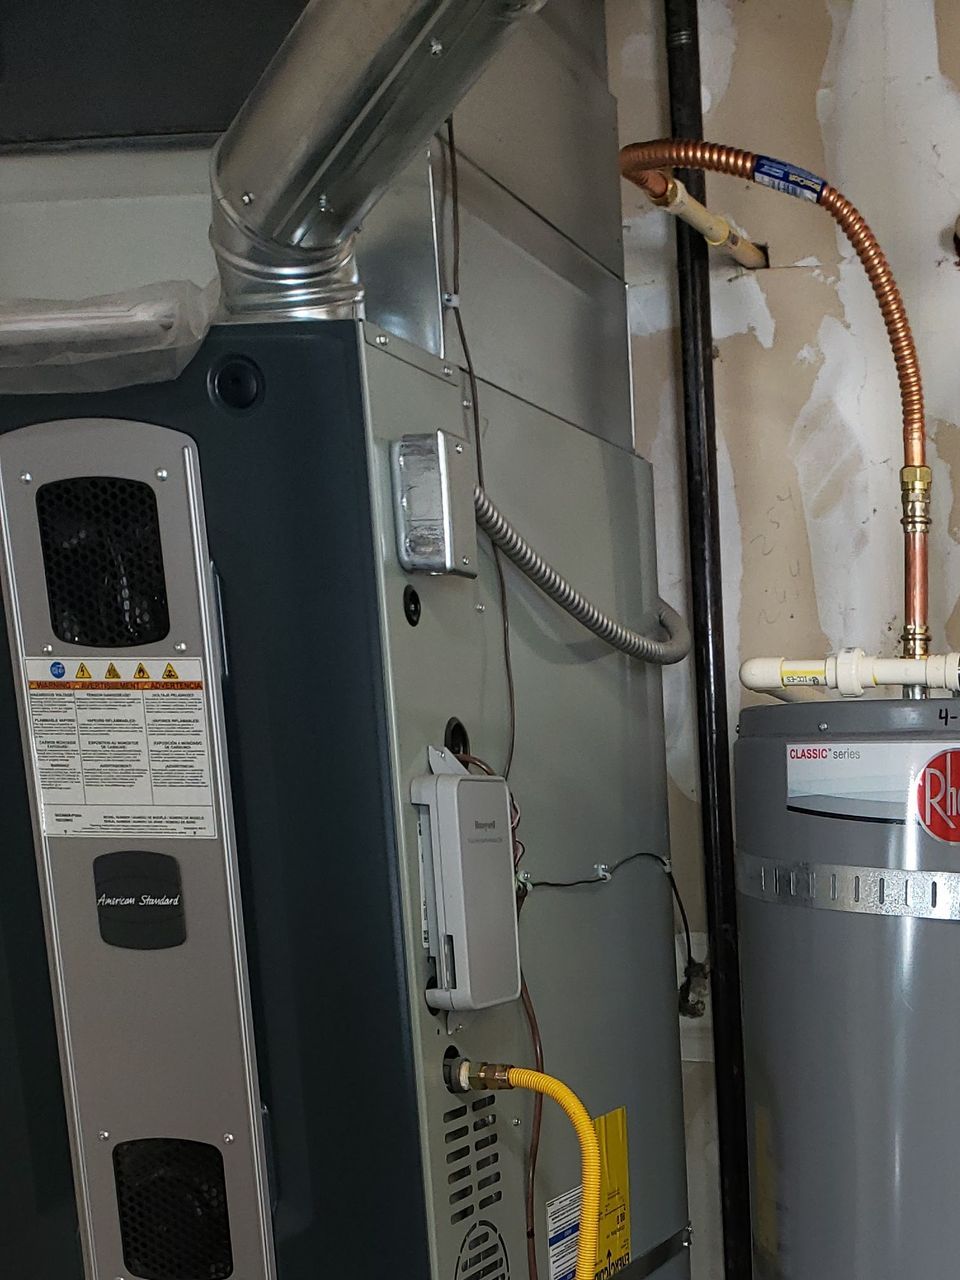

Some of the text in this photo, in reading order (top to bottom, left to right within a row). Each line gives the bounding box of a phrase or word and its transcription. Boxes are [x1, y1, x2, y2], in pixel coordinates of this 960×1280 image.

[833, 748, 861, 759] series
[97, 893, 180, 906] American Standard
